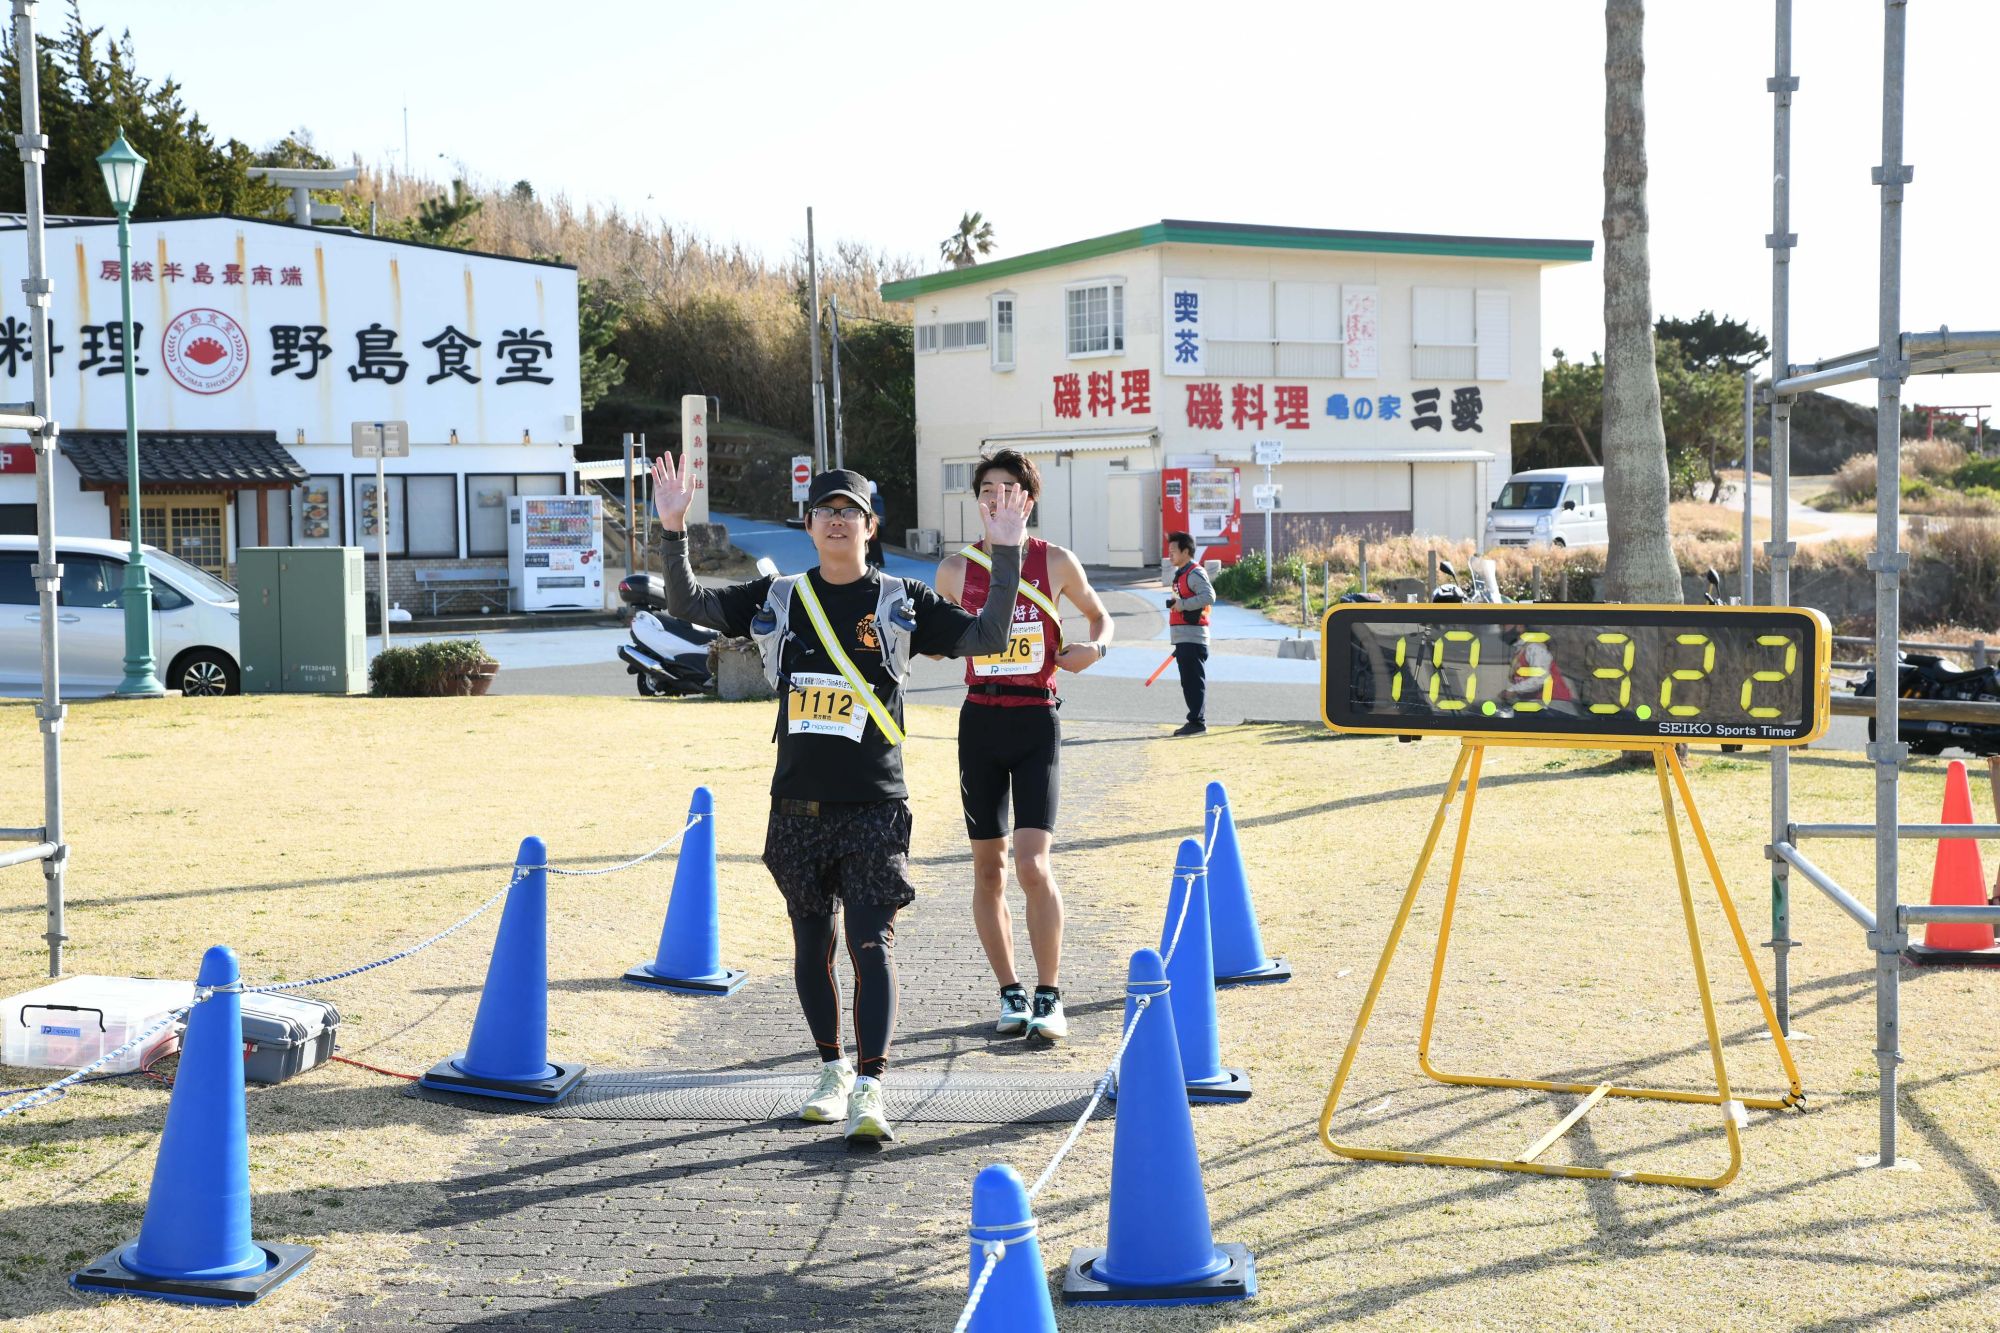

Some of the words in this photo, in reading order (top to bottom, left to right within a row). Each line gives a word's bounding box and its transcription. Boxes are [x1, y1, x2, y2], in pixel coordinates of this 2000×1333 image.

[100, 260, 304, 286] 房総半島最南端
[1174, 290, 1199, 363] 喫茶
[269, 323, 554, 385] 野島食堂
[176, 366, 203, 387] NOJIMA
[1053, 369, 1151, 419] 磯料理
[1186, 383, 1310, 430] 磯料理
[1326, 394, 1401, 420] 亀の家
[1410, 386, 1483, 433] 三愛
[800, 690, 853, 717] 1112
[1659, 723, 1712, 734] SEIKO
[1716, 725, 1757, 736] Sports
[1761, 726, 1797, 737] Timer
